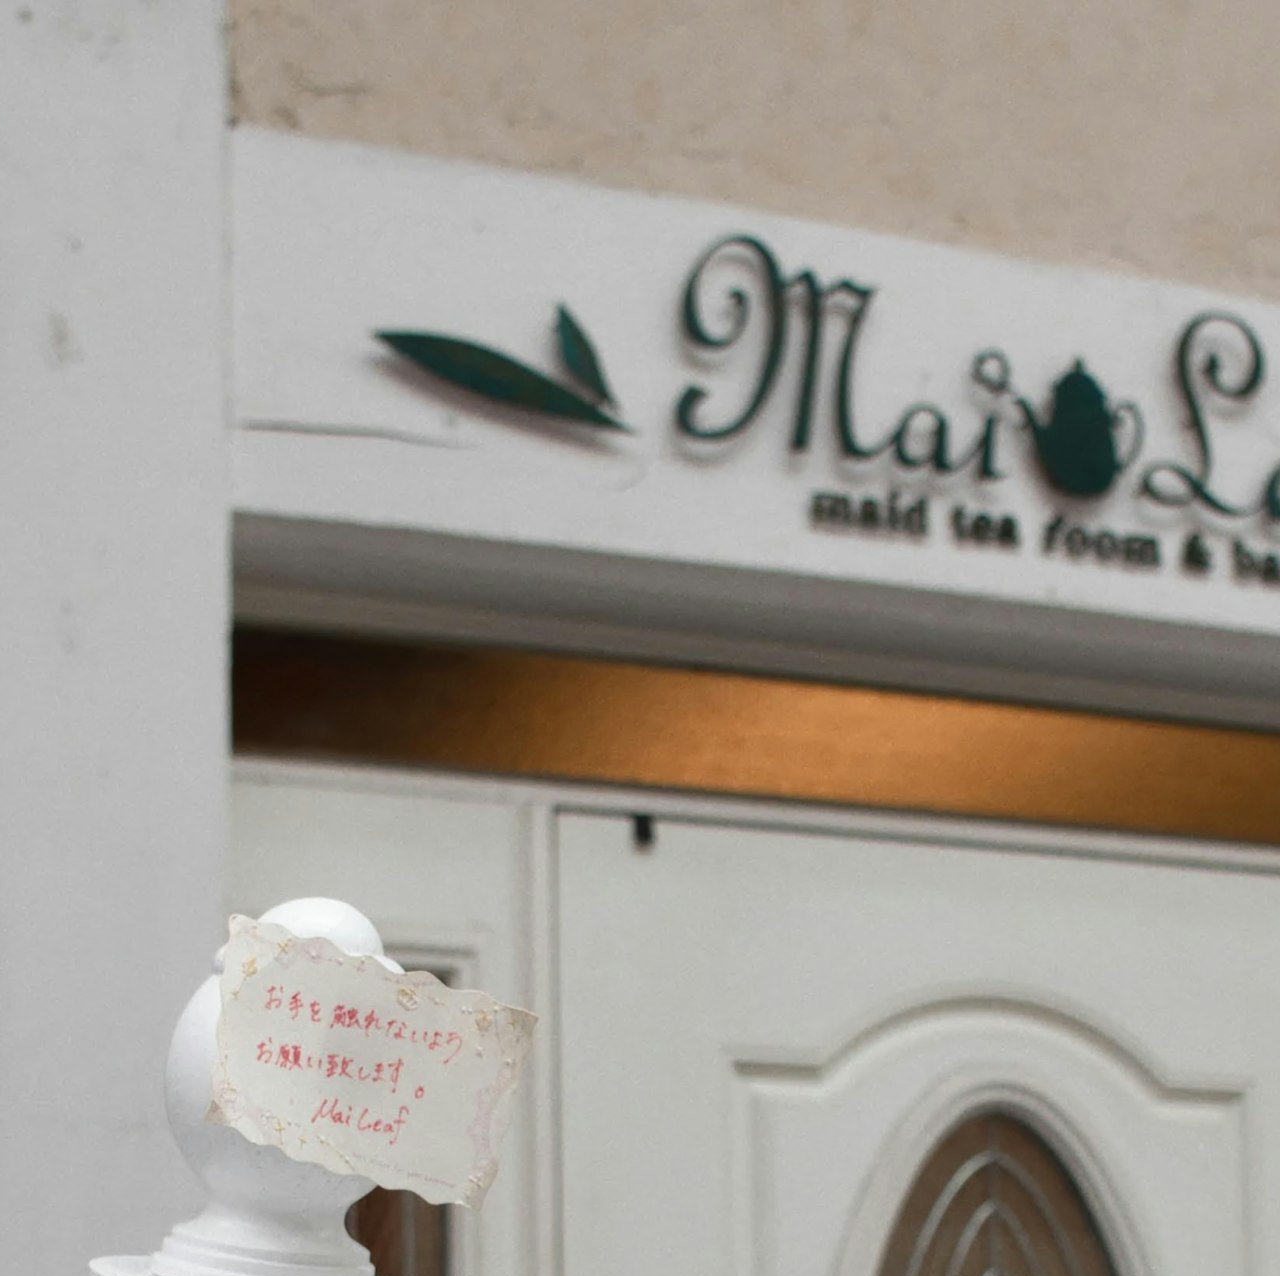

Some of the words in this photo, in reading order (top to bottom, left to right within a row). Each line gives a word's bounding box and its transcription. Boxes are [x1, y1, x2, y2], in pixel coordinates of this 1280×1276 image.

[675, 233, 1011, 480] Mai
[811, 490, 927, 535] maid
[953, 502, 1020, 548] tea
[1042, 516, 1160, 567] room
[1182, 531, 1211, 576] &
[311, 1099, 352, 1125] Mai
[357, 1106, 410, 1146] Leaf
